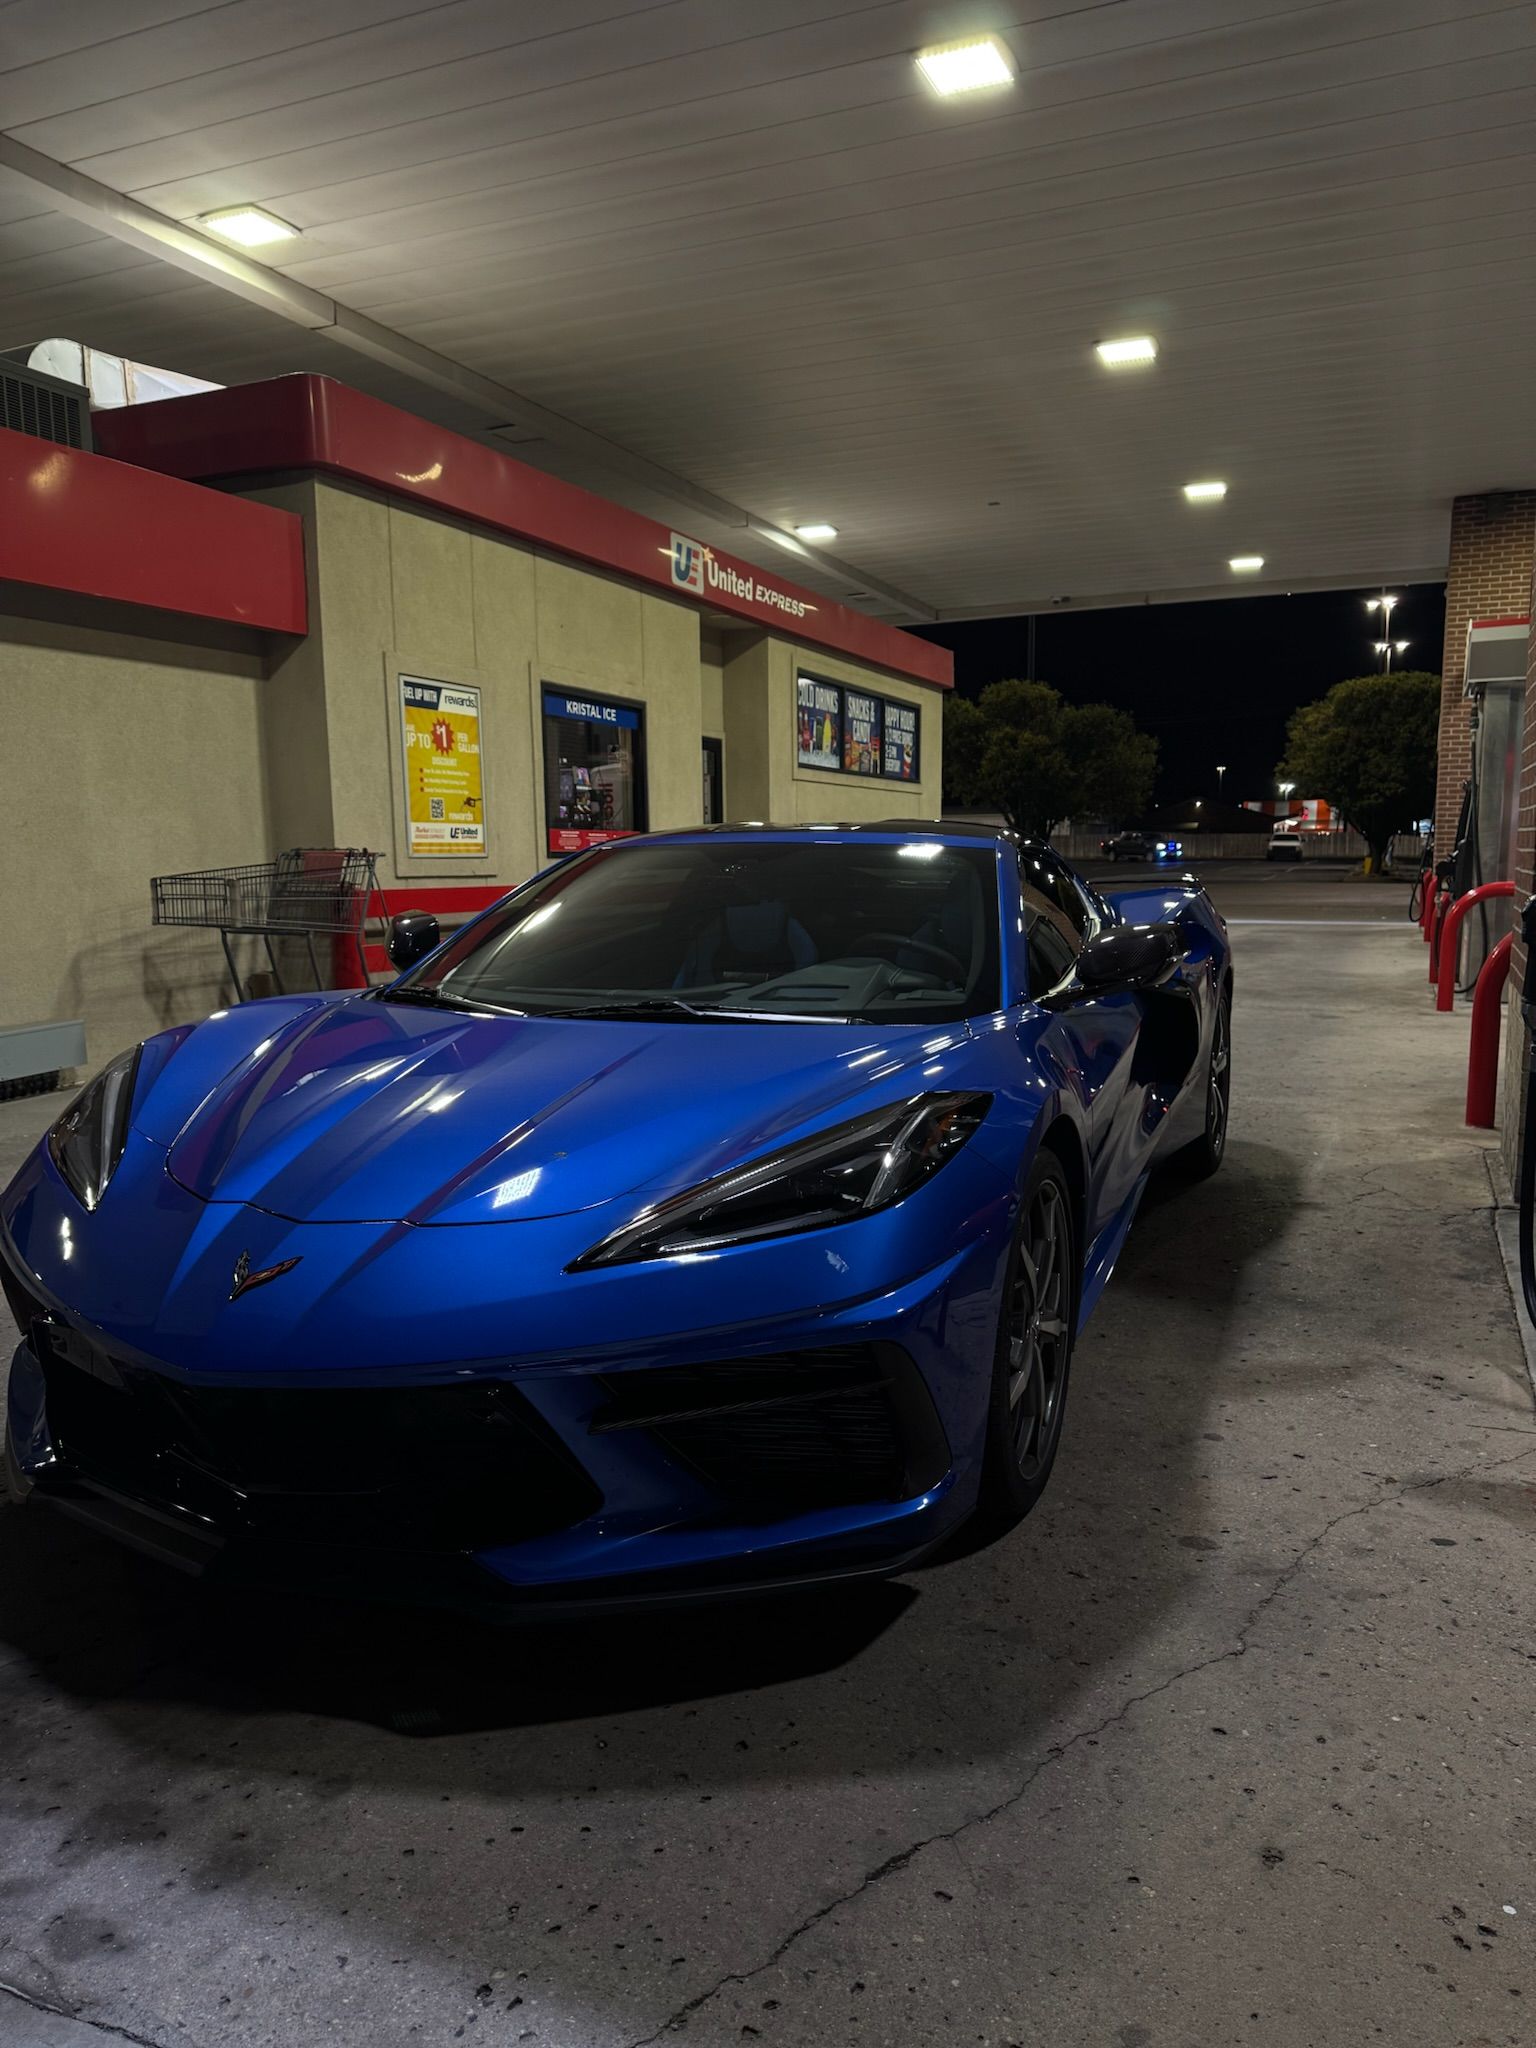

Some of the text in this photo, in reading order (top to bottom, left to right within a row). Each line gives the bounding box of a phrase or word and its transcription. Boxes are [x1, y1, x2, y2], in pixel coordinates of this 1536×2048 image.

[707, 559, 753, 601] United
[755, 584, 805, 618] EXPRESS
[566, 700, 617, 722] KRISTAL ICE
[815, 686, 839, 714] DRINKS
[848, 695, 870, 721] SNACKS
[417, 732, 431, 750] TO
